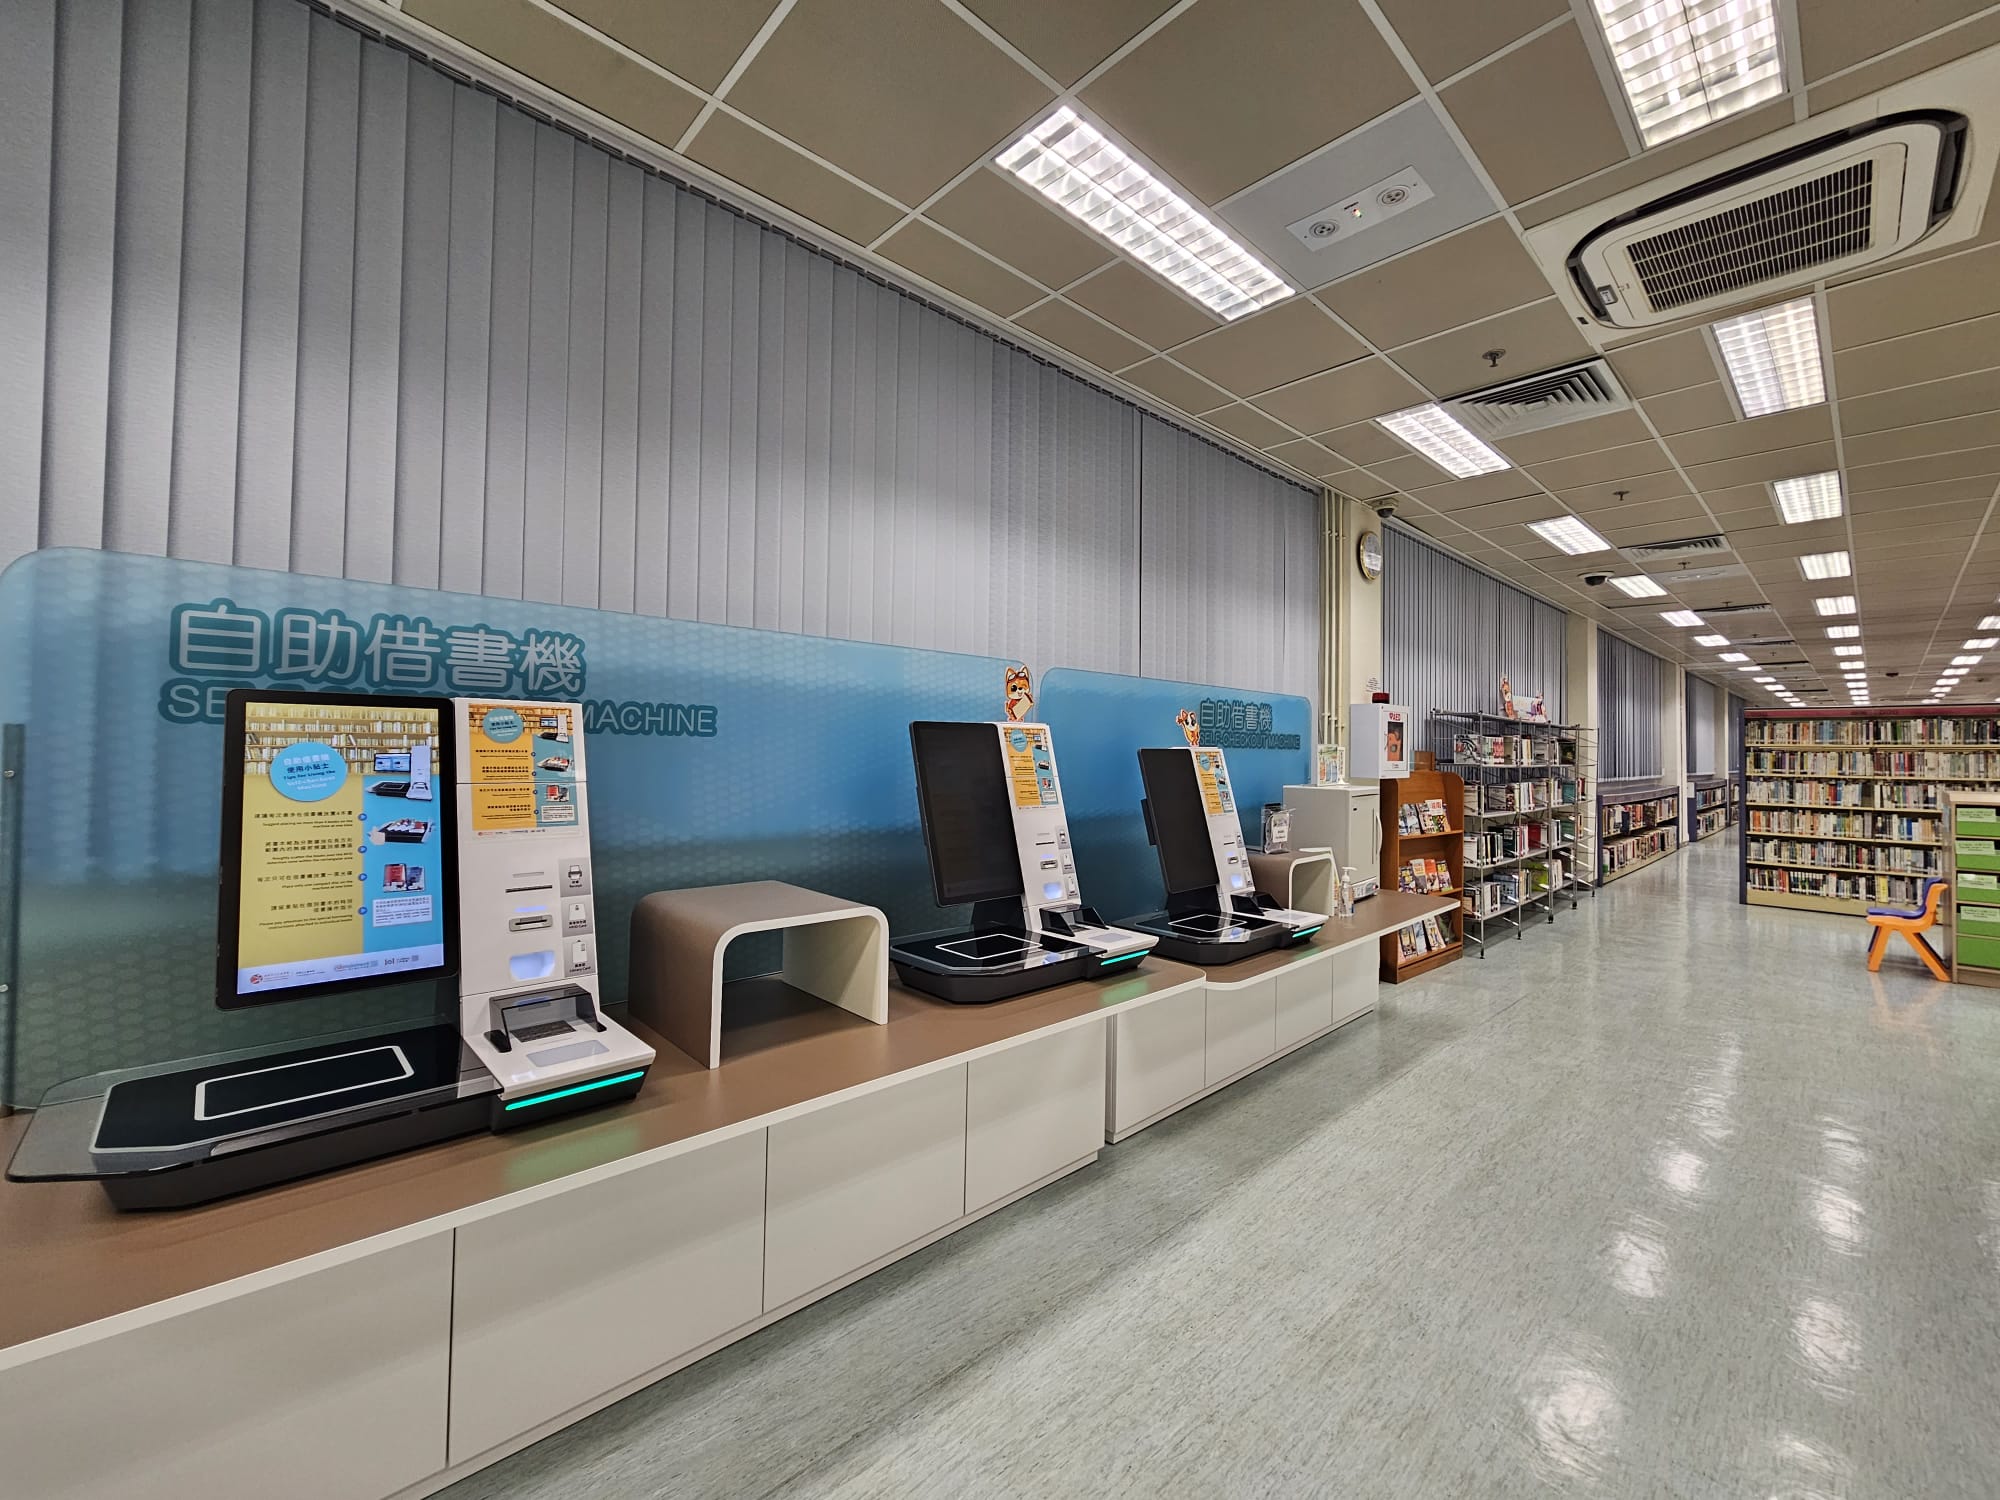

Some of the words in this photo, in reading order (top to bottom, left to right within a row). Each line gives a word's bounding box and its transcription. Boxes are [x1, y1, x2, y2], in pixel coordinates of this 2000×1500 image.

[177, 603, 583, 693] 自助借書機
[1200, 699, 1272, 731] 自助借書機
[1200, 731, 1267, 748] SELF-CHECKOUT
[1268, 734, 1301, 749] MACHINE
